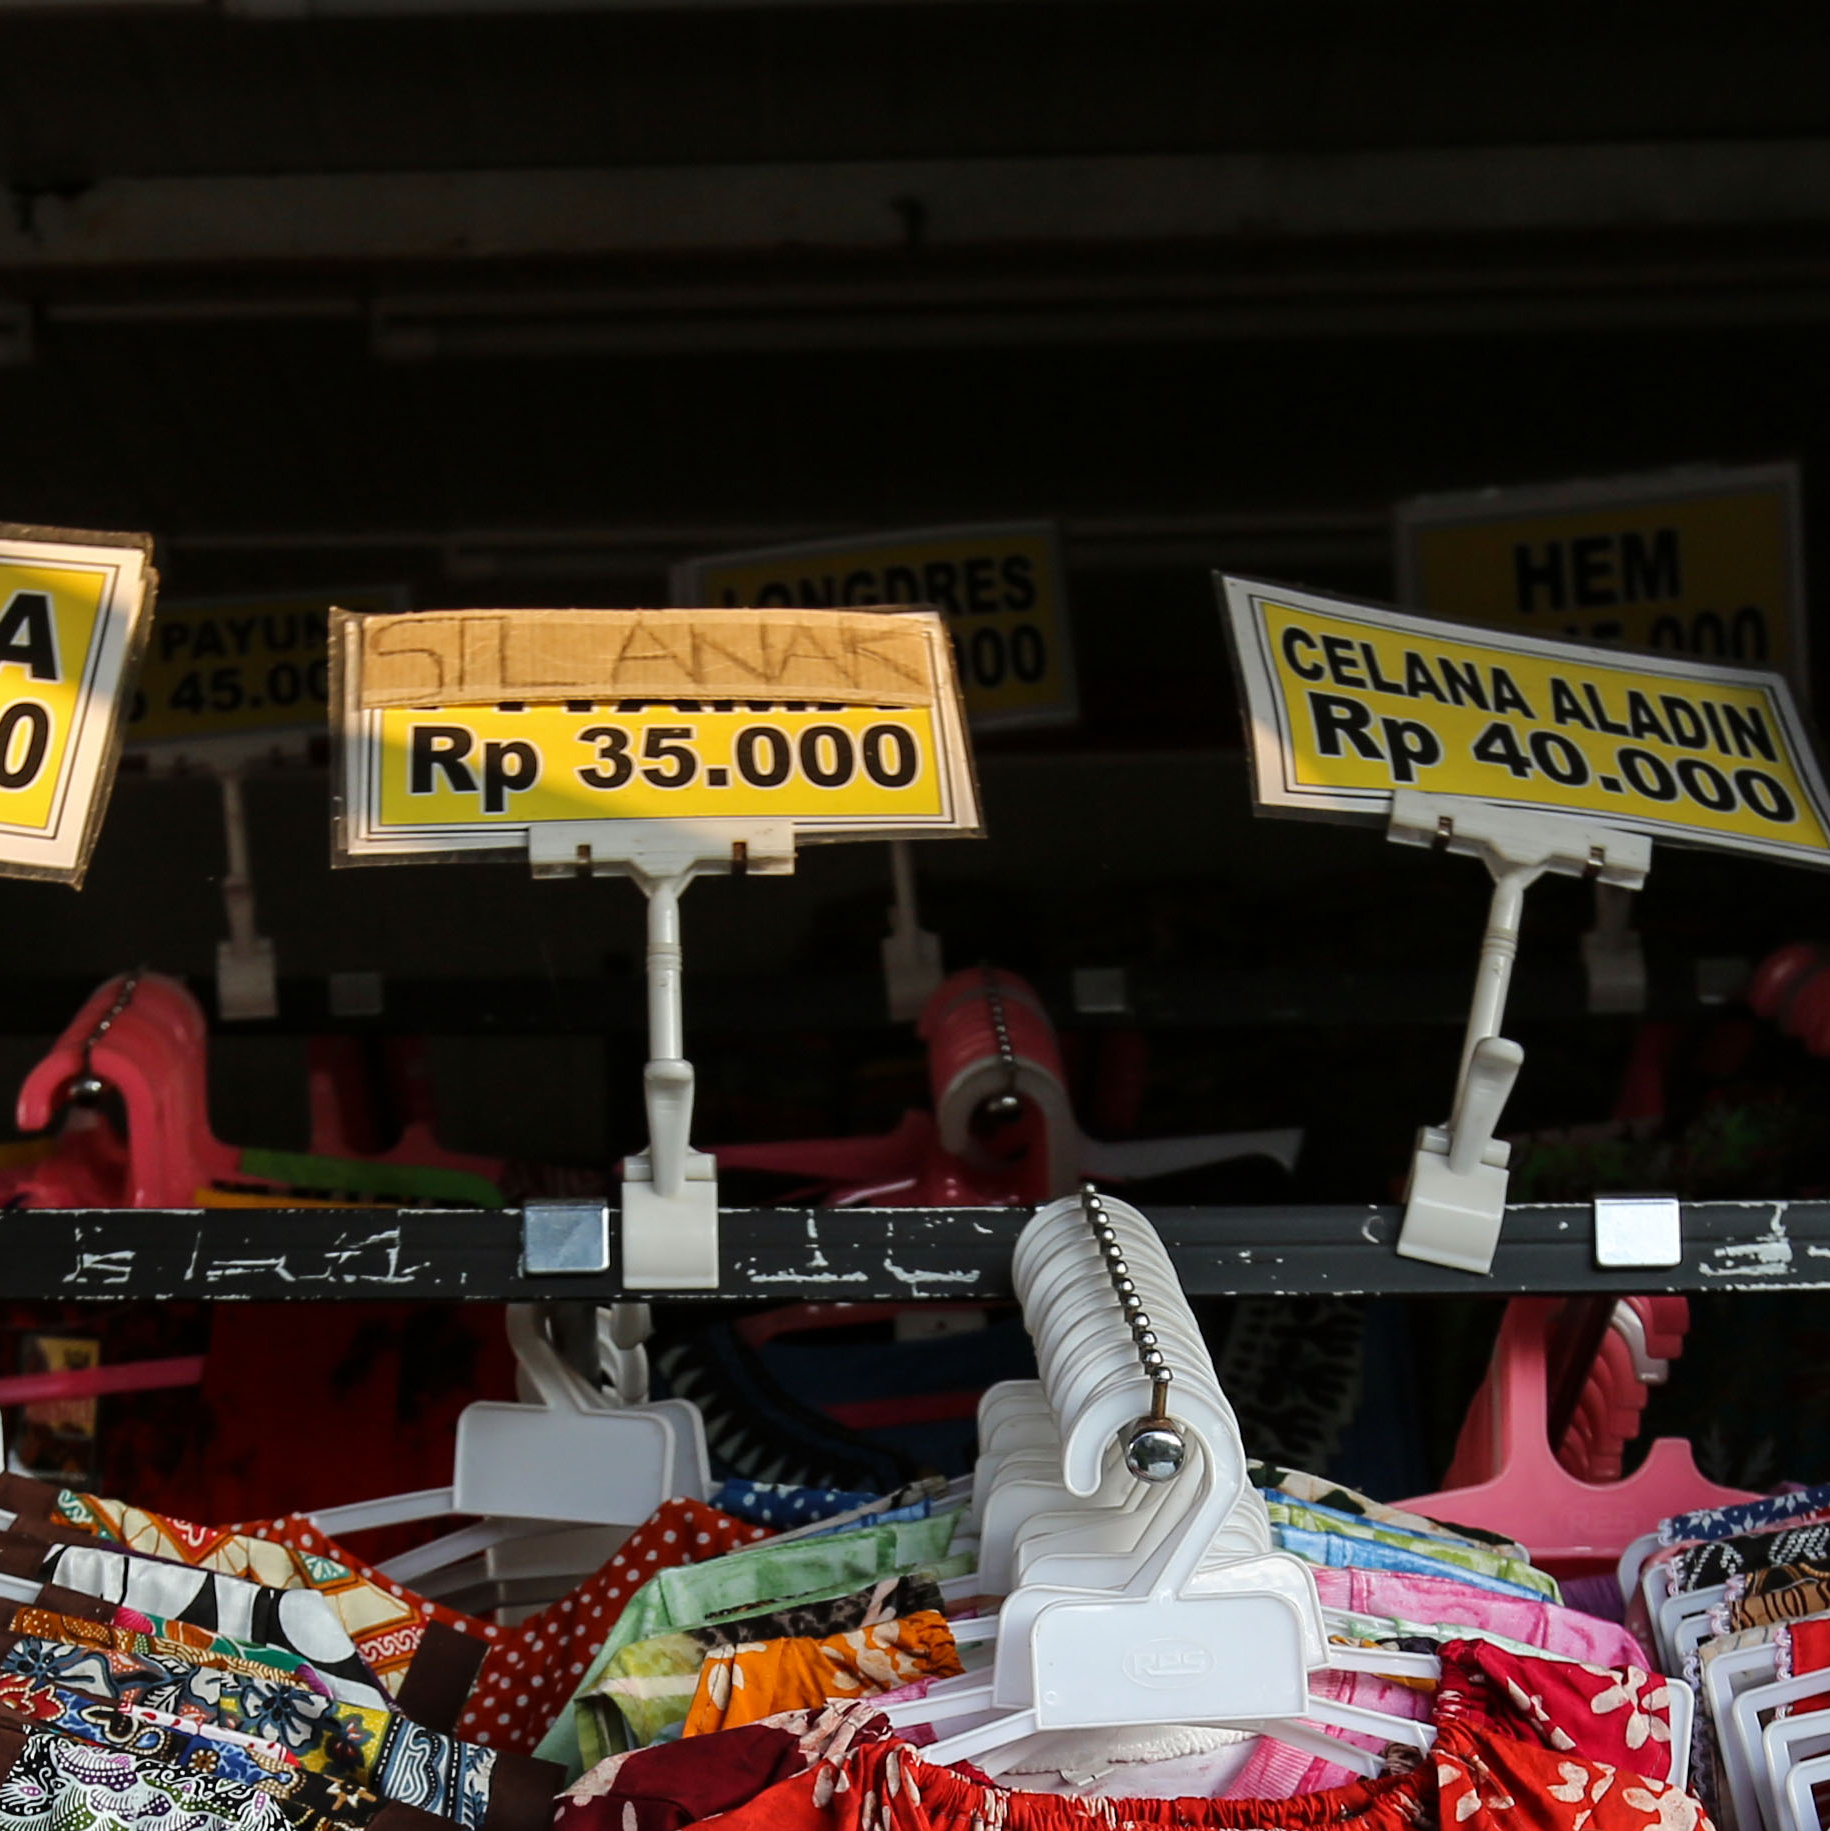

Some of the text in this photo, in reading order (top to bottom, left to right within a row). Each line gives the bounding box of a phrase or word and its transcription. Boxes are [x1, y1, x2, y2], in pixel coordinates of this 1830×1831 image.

[1516, 530, 1680, 612] HEM
[170, 660, 328, 713] 45.00
[610, 615, 929, 691] ANAK
[1281, 627, 1778, 763] CELANA ALADIN
[409, 724, 918, 813] Rp 35.000
[1307, 690, 1797, 824] Rp 40.000
